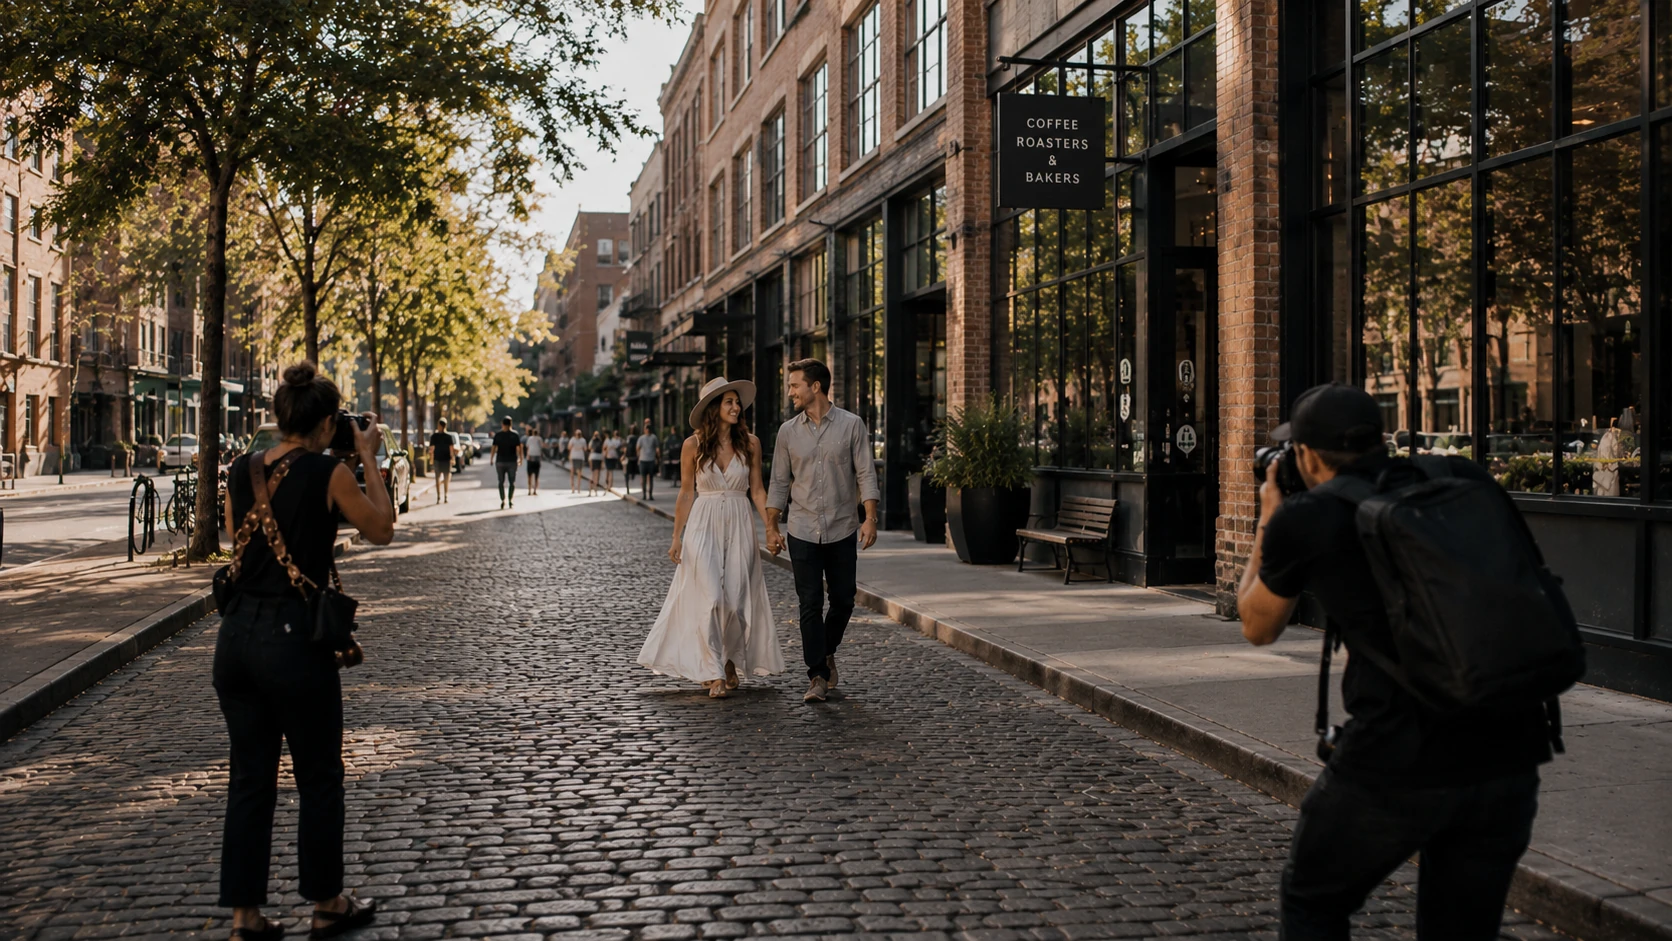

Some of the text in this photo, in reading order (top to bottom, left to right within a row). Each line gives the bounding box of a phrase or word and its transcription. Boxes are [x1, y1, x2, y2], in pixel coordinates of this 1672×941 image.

[1026, 118, 1078, 130] COFFEE
[1016, 136, 1089, 150] ROASTERS
[1048, 154, 1057, 166] &
[1025, 172, 1080, 184] BAKERS
